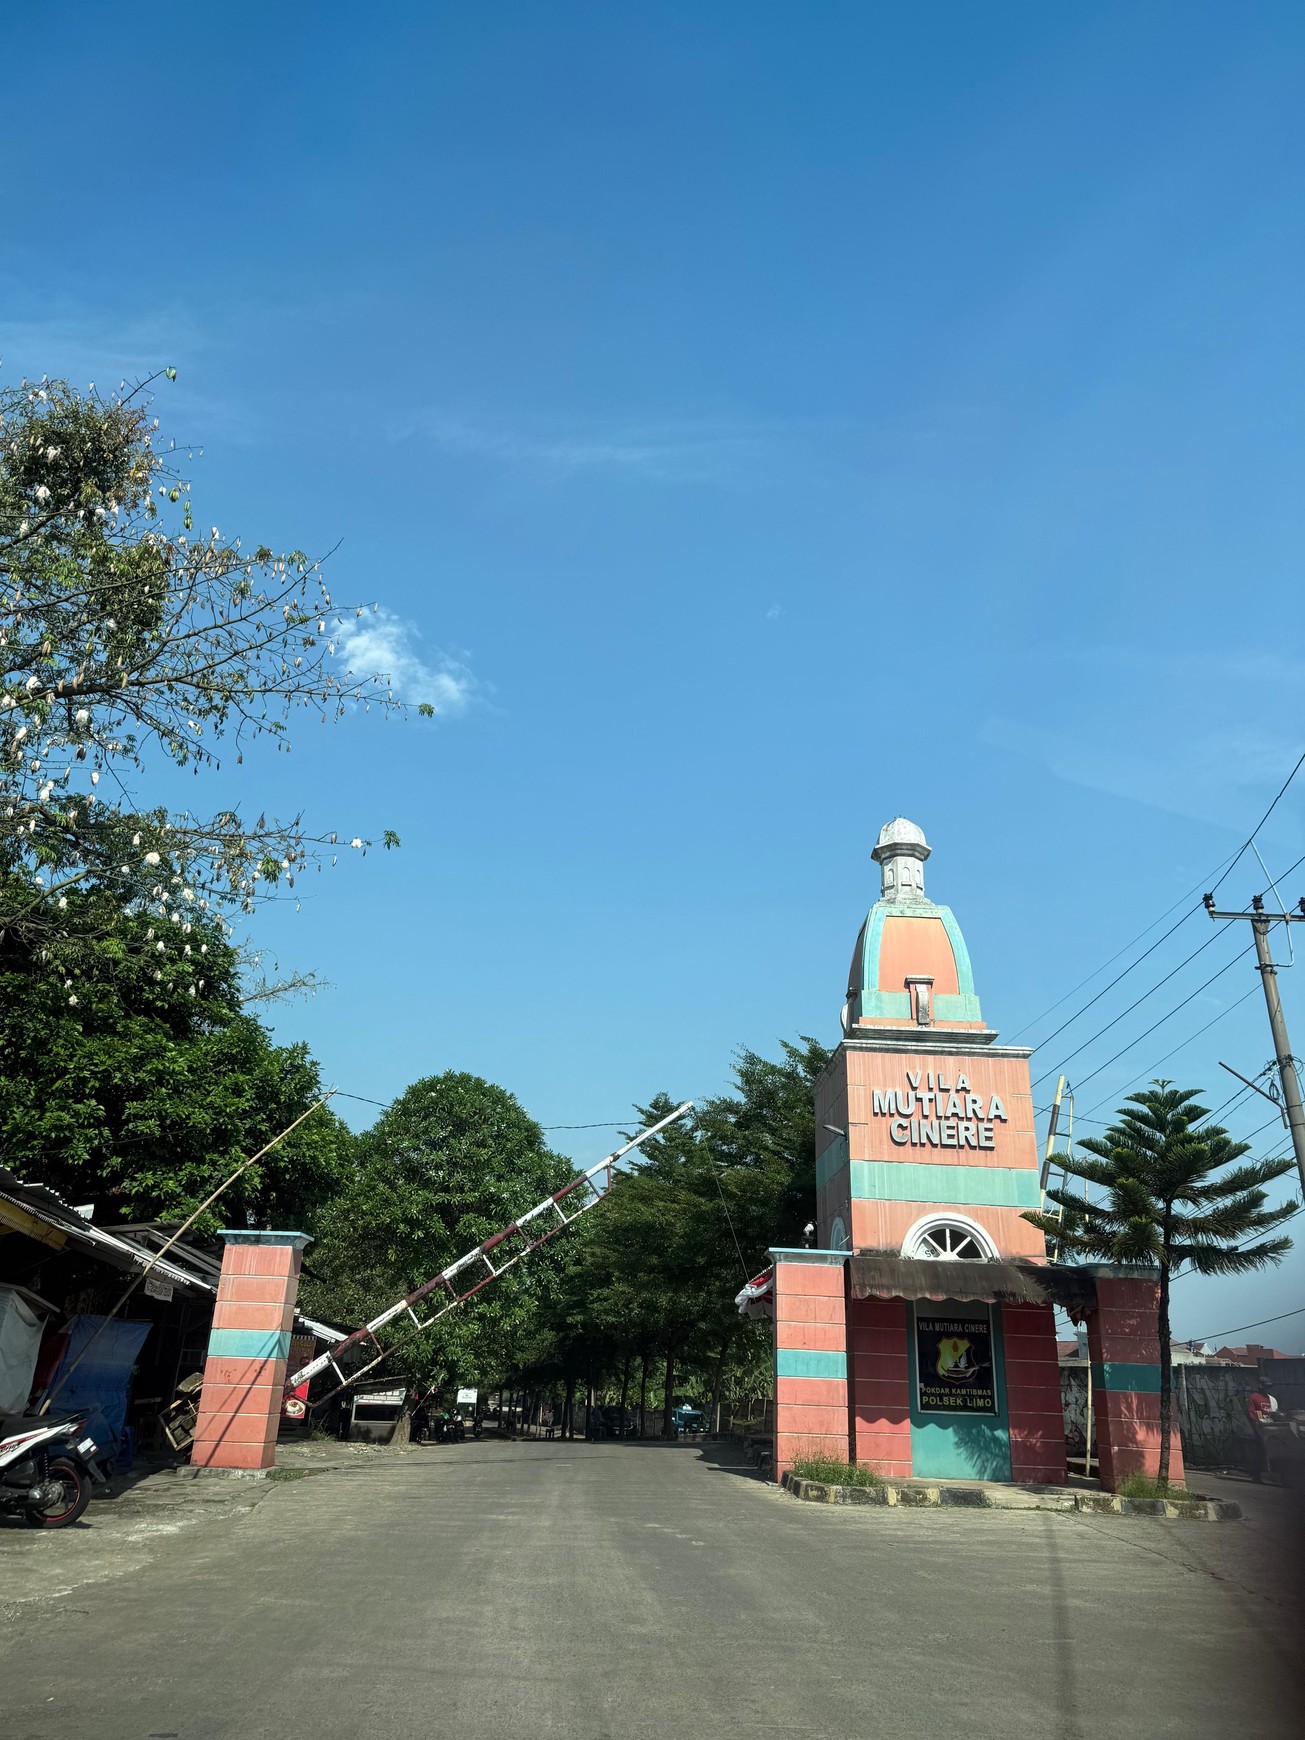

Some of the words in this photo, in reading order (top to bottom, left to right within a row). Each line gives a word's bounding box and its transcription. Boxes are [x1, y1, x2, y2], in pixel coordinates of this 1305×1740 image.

[906, 1071, 971, 1092] VILA
[872, 1089, 1008, 1123] MUTIARA
[890, 1118, 996, 1150] CINERE
[918, 1321, 934, 1331] VILA
[934, 1322, 963, 1333] MUTIARA
[964, 1323, 988, 1334] CINERE
[921, 1386, 950, 1394] POKDAR
[951, 1388, 992, 1396] KAMTIBMAS
[922, 1396, 963, 1406] POLSEK
[967, 1397, 992, 1407] LIMO
